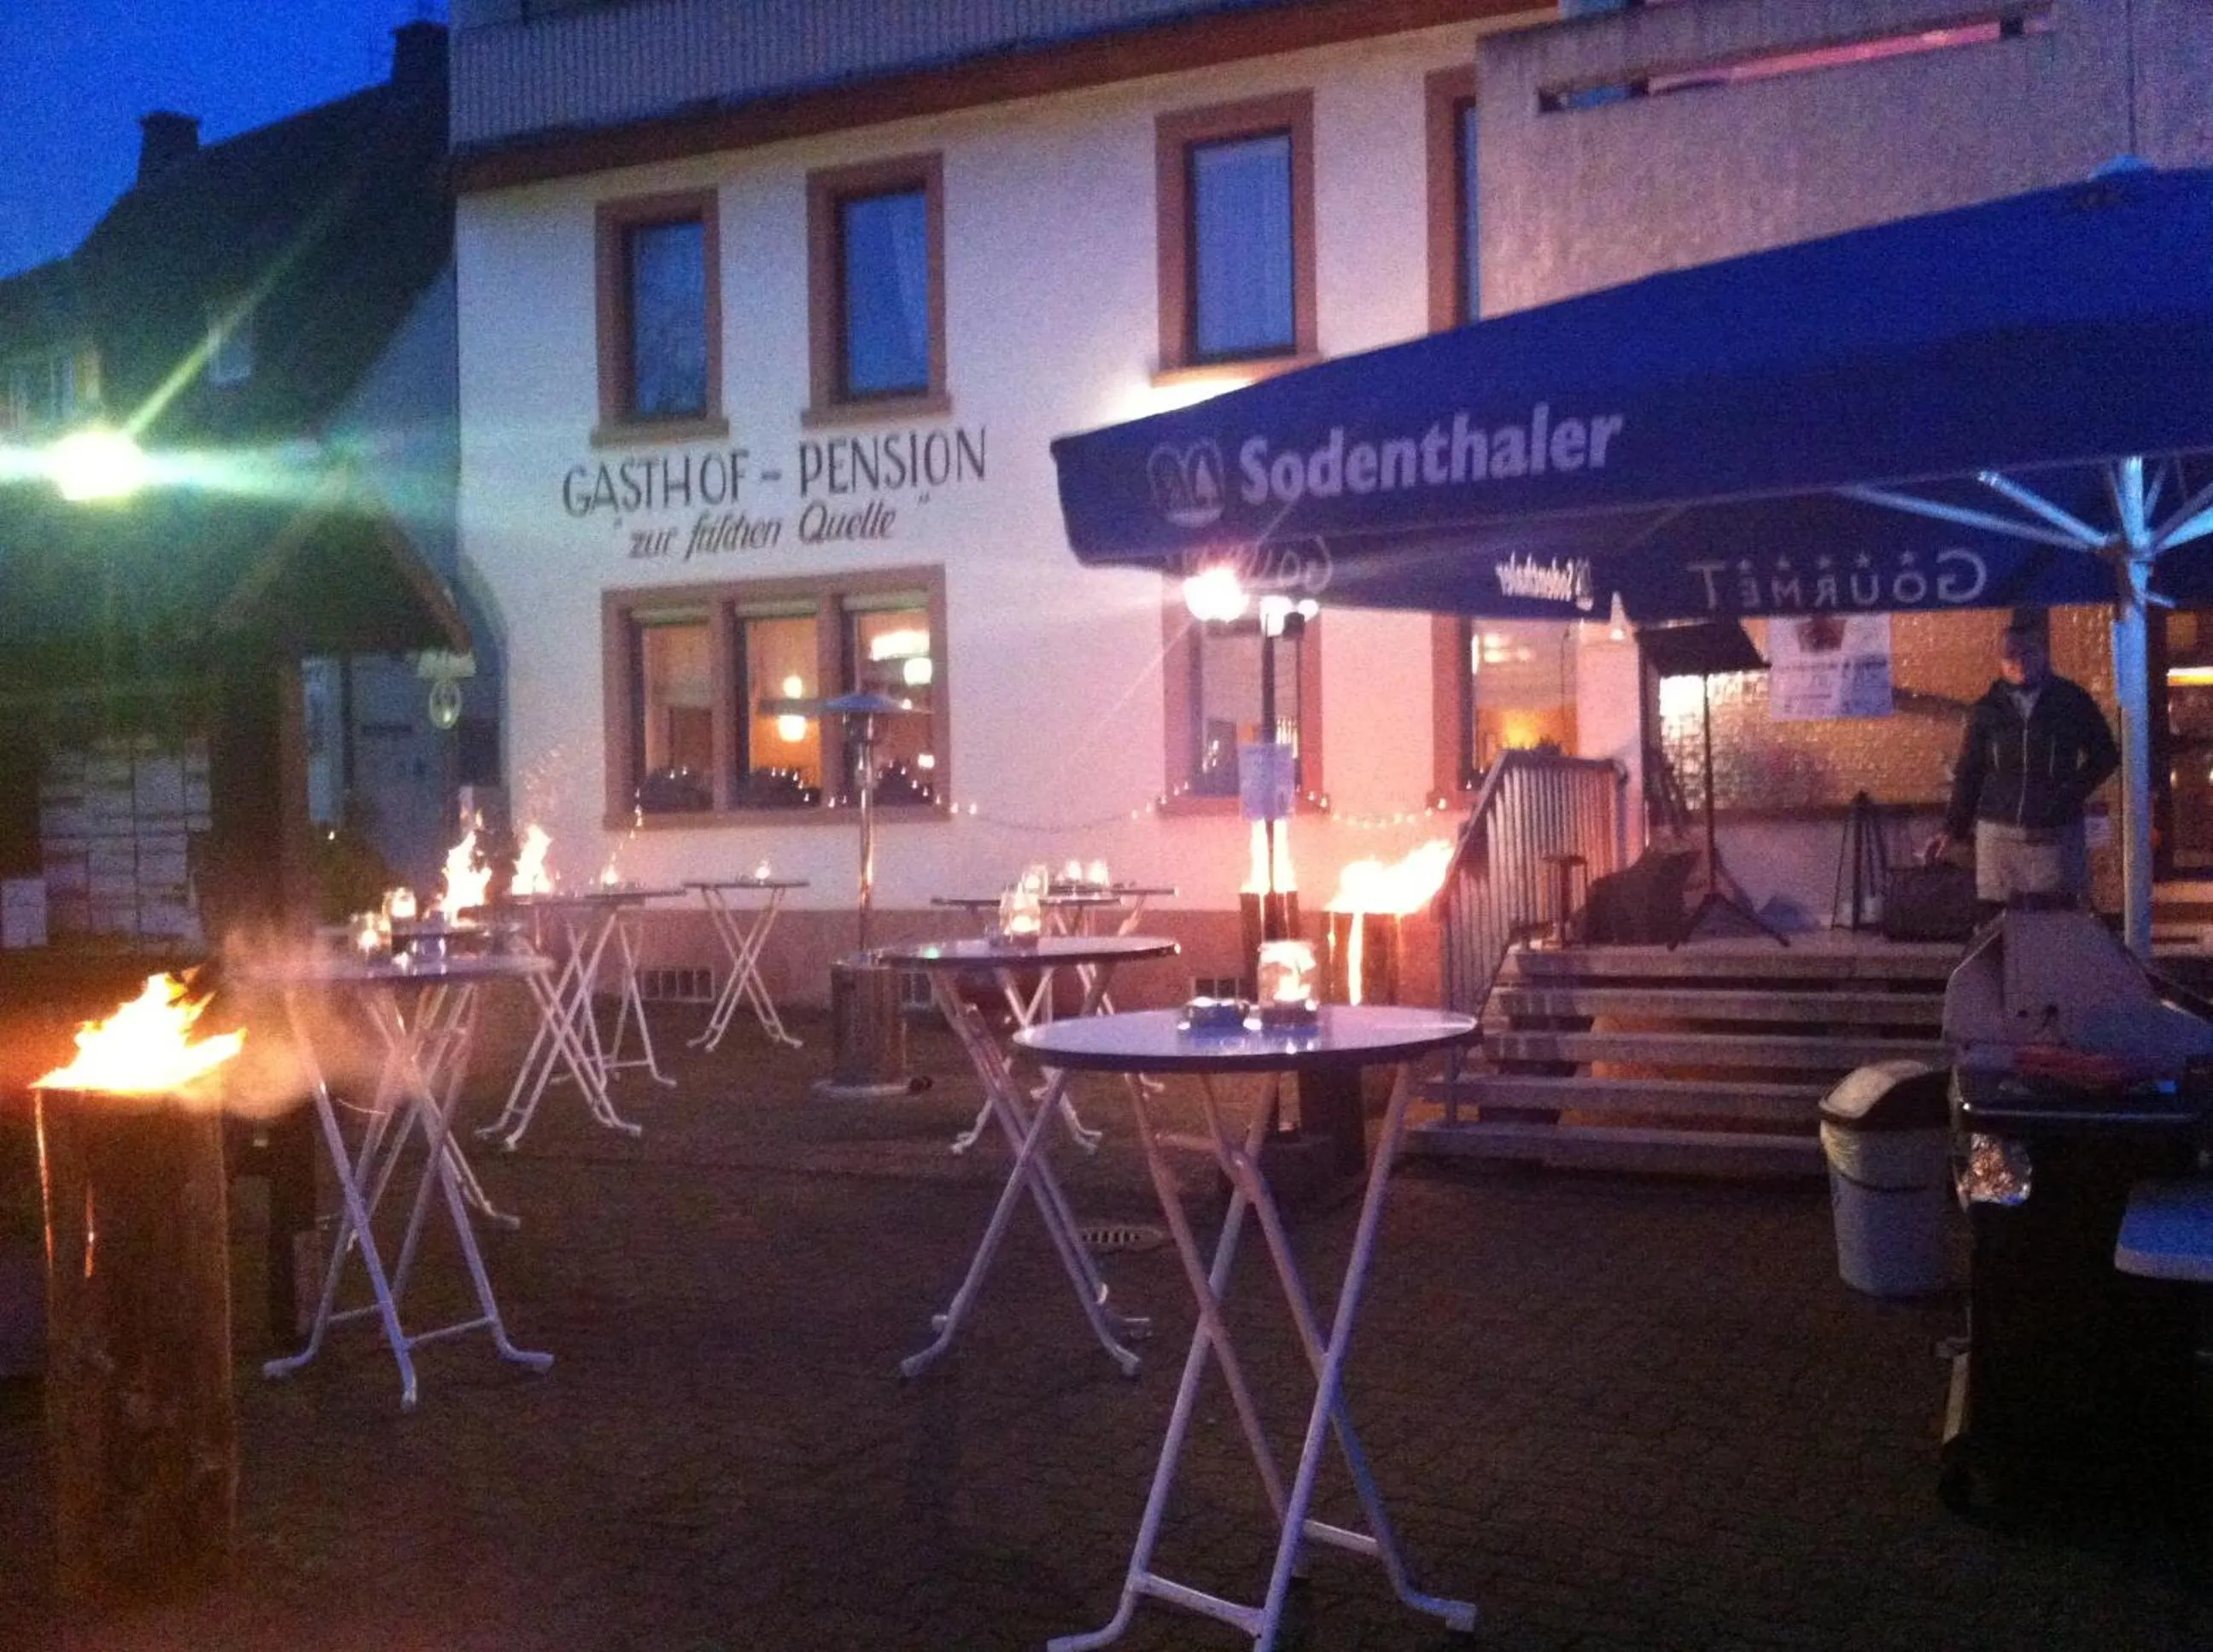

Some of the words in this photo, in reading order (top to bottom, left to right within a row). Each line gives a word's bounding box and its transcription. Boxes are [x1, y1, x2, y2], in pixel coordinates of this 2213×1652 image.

[563, 448, 750, 517] GASTHOF
[798, 426, 986, 498] PENSION
[1238, 404, 1623, 505] Sodenthaler
